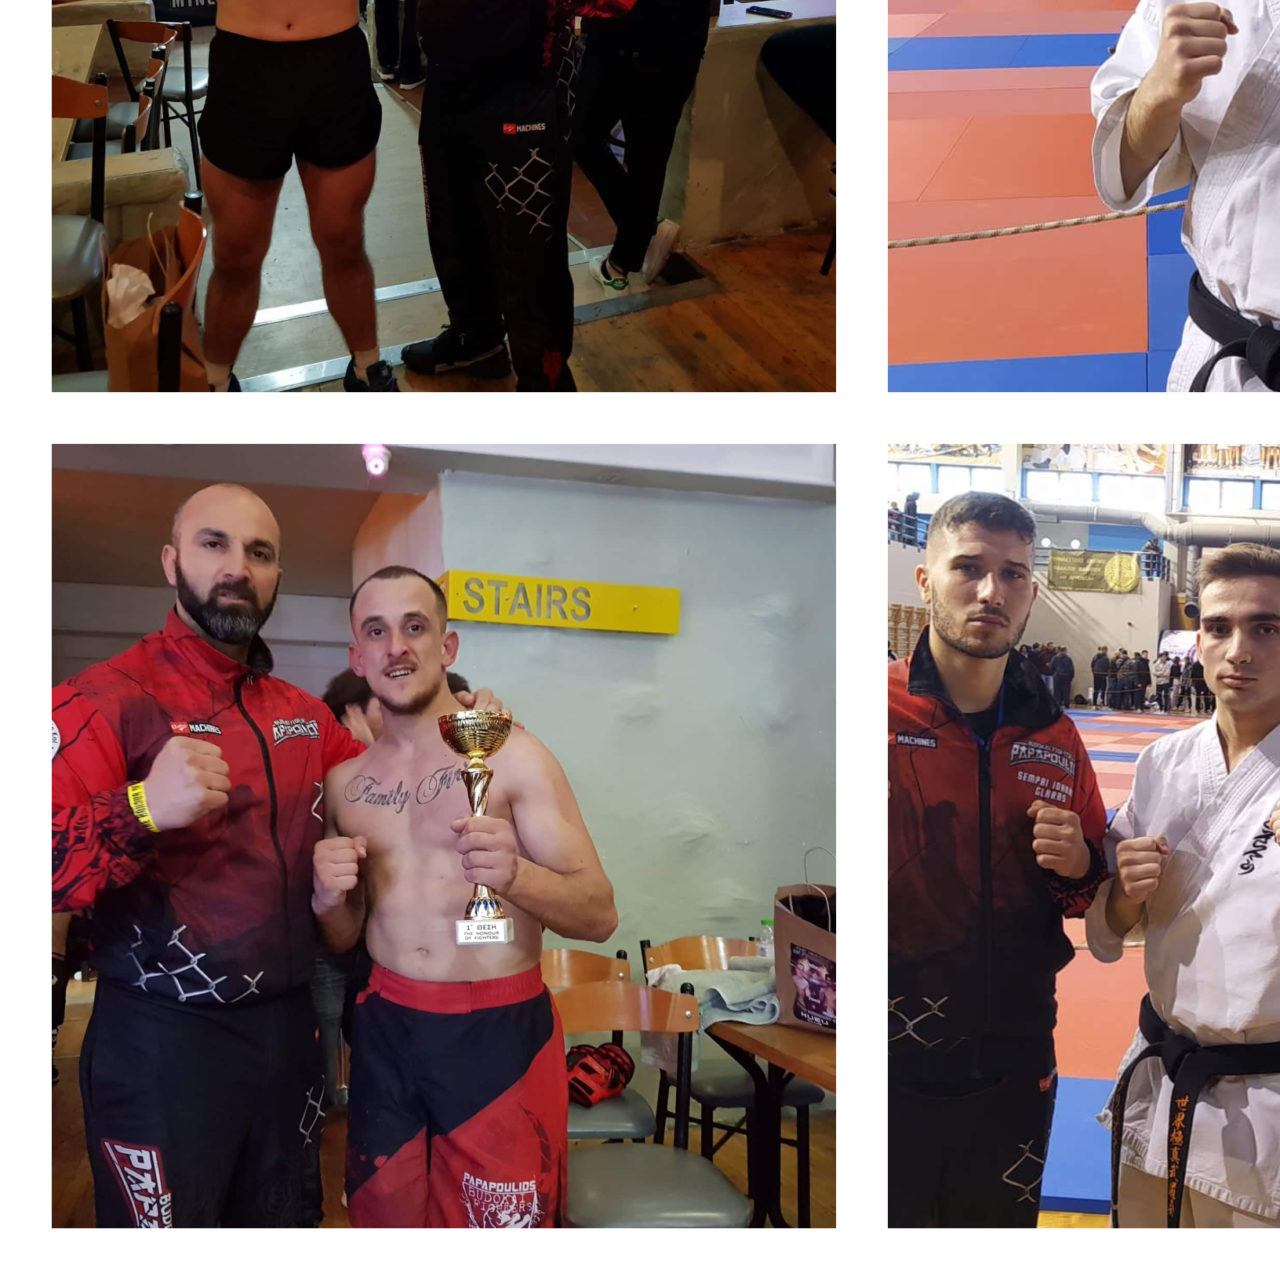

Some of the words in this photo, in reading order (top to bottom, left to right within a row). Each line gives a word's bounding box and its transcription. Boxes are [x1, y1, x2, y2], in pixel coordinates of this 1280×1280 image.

[463, 577, 592, 622] STAIRS
[897, 735, 937, 748] MACHINES
[1011, 744, 1075, 777] PAPAPOULI
[344, 775, 410, 814] Family
[463, 1172, 536, 1193] PAPAPOULIOS
